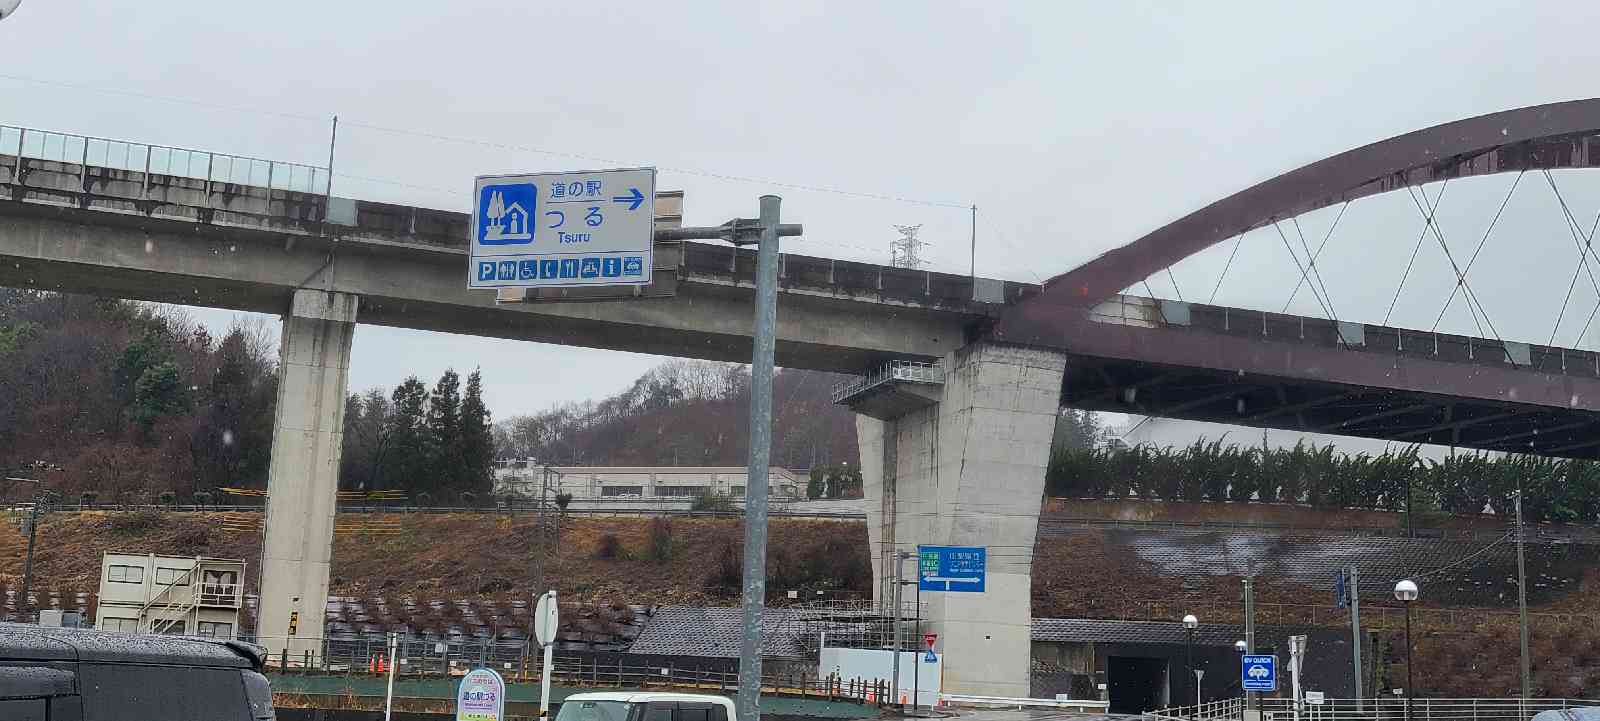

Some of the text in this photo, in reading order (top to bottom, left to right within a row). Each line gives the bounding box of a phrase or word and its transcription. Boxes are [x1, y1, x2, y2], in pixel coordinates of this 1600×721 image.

[551, 180, 602, 199] 道の駅
[545, 206, 604, 229] つる
[558, 230, 592, 244] Tsuru
